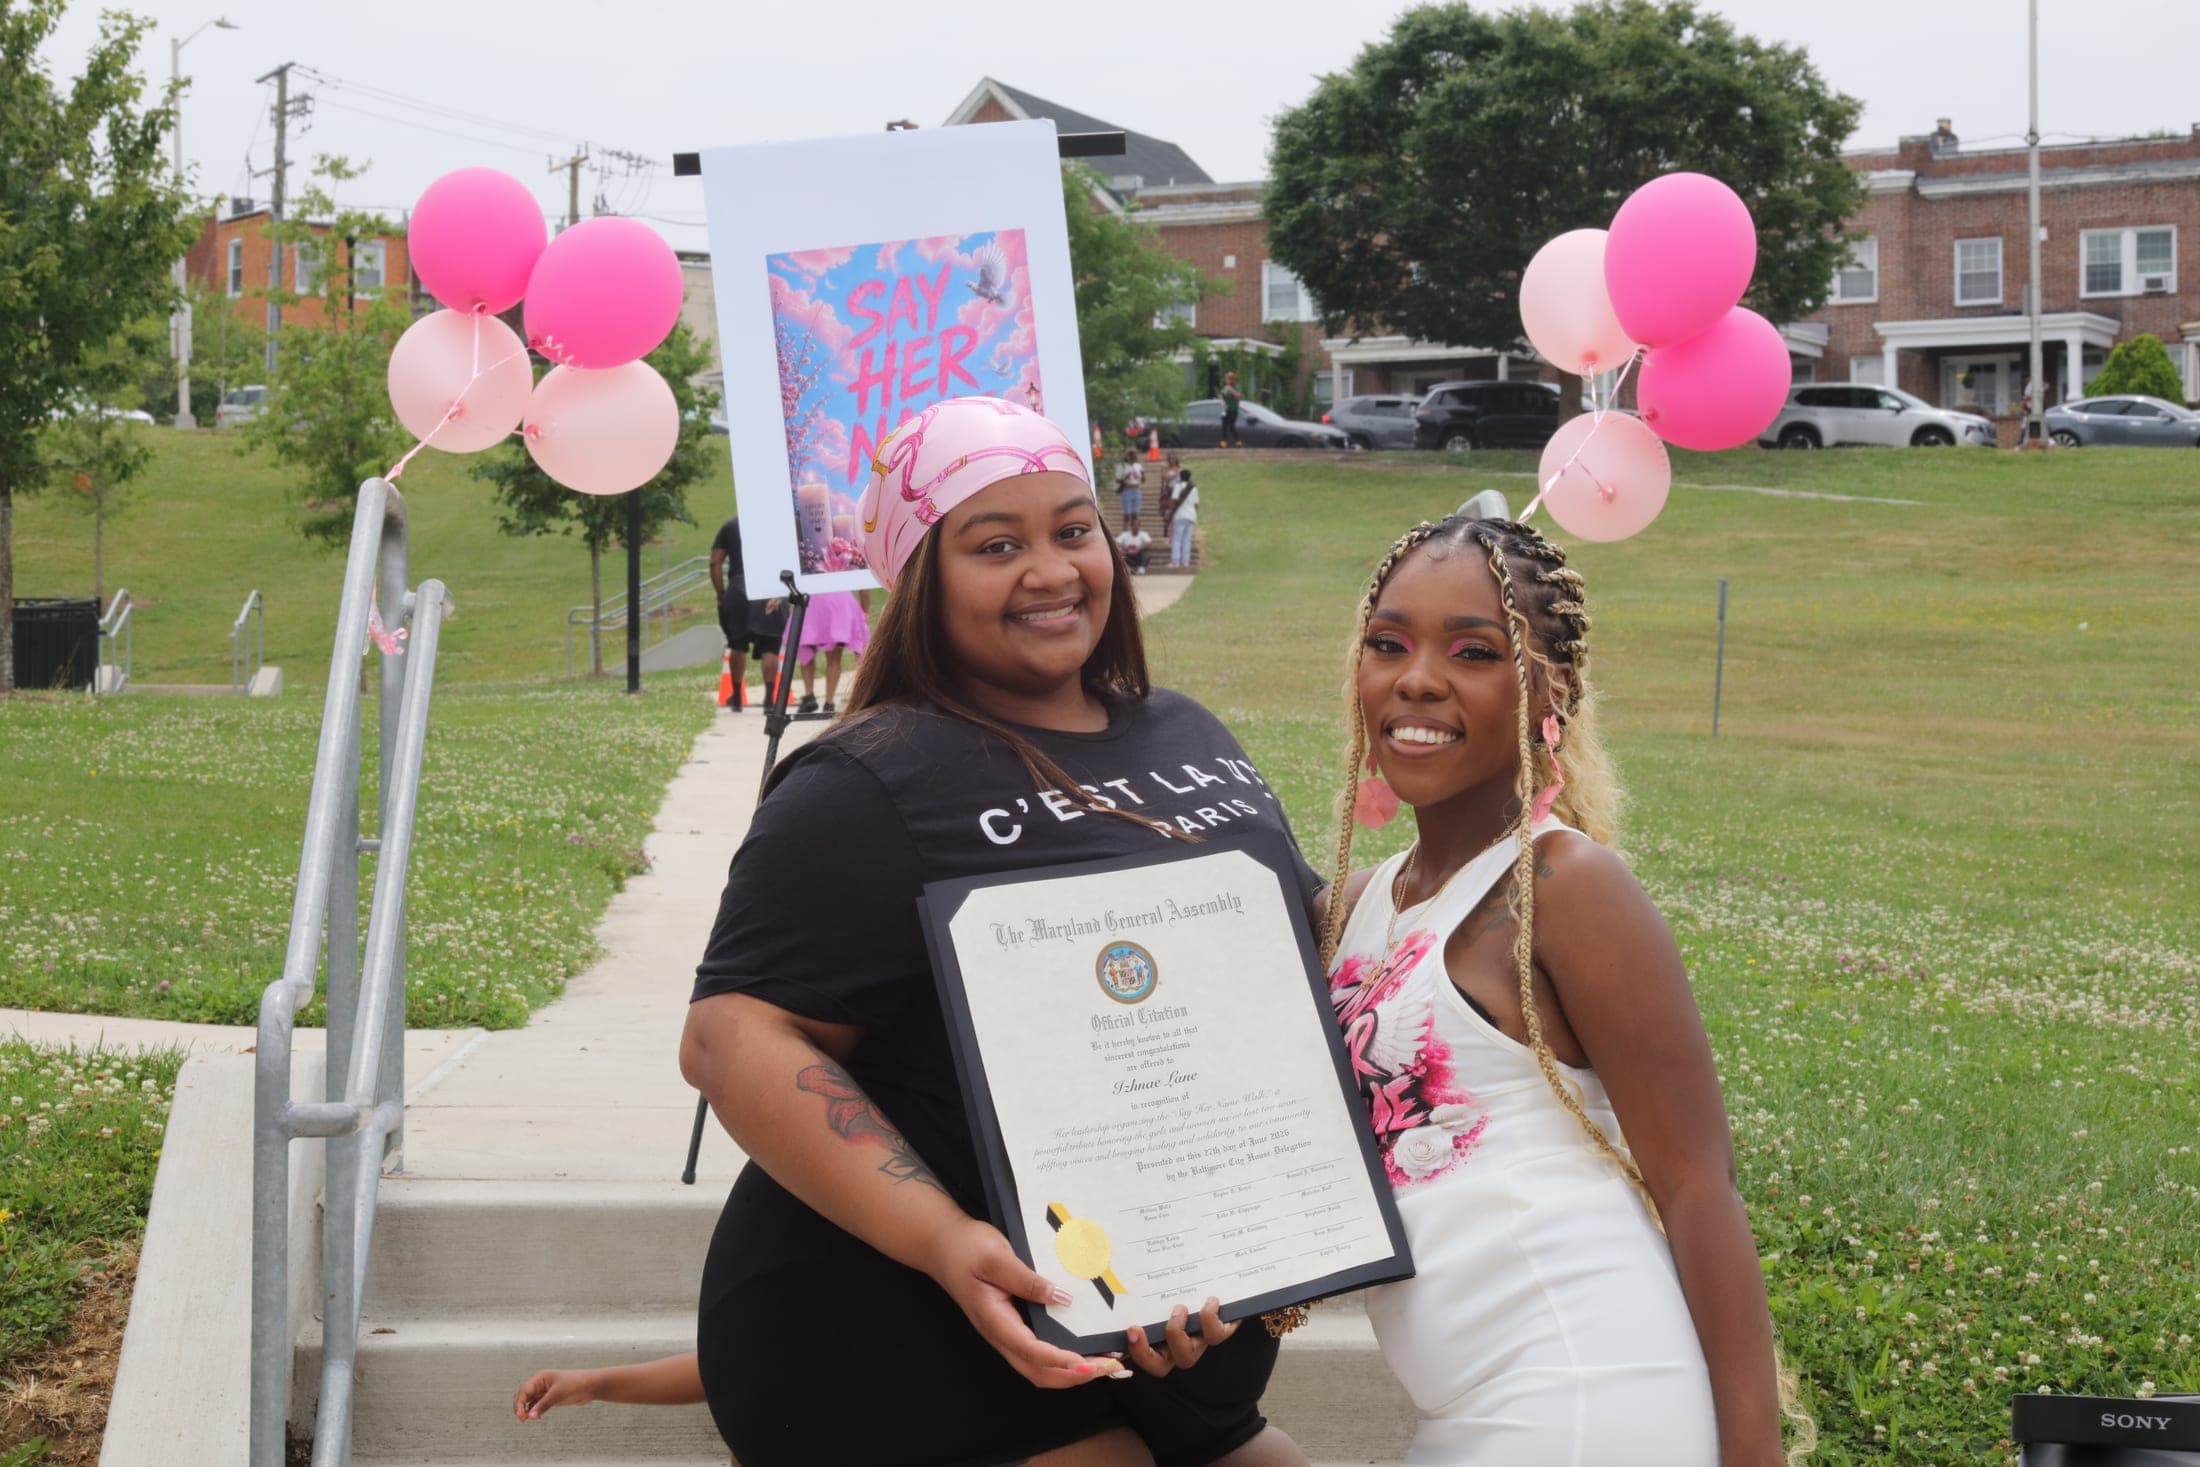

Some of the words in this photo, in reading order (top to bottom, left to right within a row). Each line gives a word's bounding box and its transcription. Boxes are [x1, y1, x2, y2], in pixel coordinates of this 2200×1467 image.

[845, 262, 953, 352] SAY
[847, 325, 981, 418] HER
[1149, 763, 1227, 795] LA
[1149, 797, 1259, 839] PARIS
[989, 921, 1026, 951] The
[1025, 917, 1101, 947] Maryland
[1104, 904, 1164, 934] General
[1165, 891, 1245, 927] Assembly
[1091, 1011, 1135, 1032] Official
[1137, 1006, 1189, 1028] Citation
[1111, 1037, 1135, 1048] hereby
[1163, 1070, 1199, 1088] Lane
[1136, 1157, 1174, 1173] Presented
[1222, 1142, 1237, 1153] day
[1238, 1138, 1247, 1149] of
[1247, 1135, 1267, 1147] June
[1228, 1156, 1245, 1168] City
[2101, 1413, 2172, 1430] SONY
